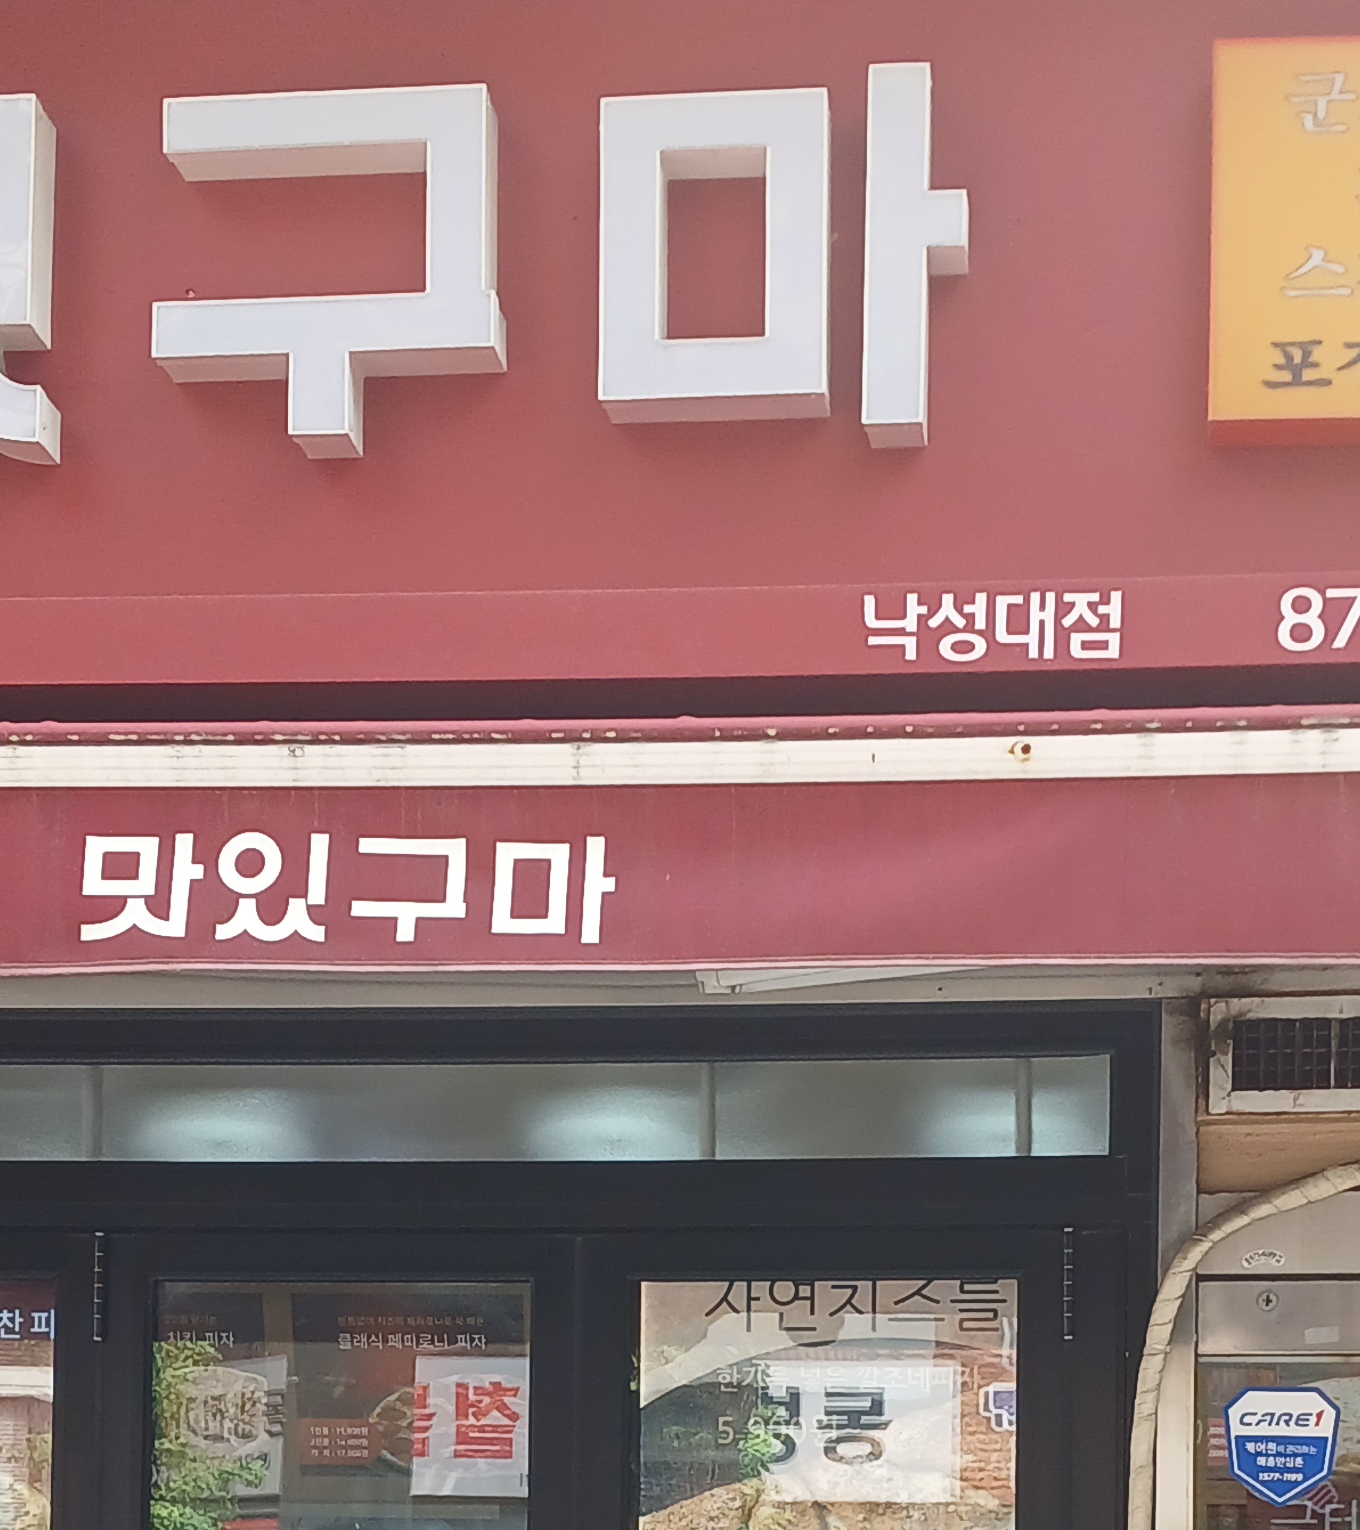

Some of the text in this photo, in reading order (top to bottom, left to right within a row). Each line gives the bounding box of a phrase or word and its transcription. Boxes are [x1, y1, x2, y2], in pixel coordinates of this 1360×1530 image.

[862, 589, 1124, 662] 낙성대점
[79, 831, 616, 944] 맛있구마
[456, 1332, 487, 1351] 피자
